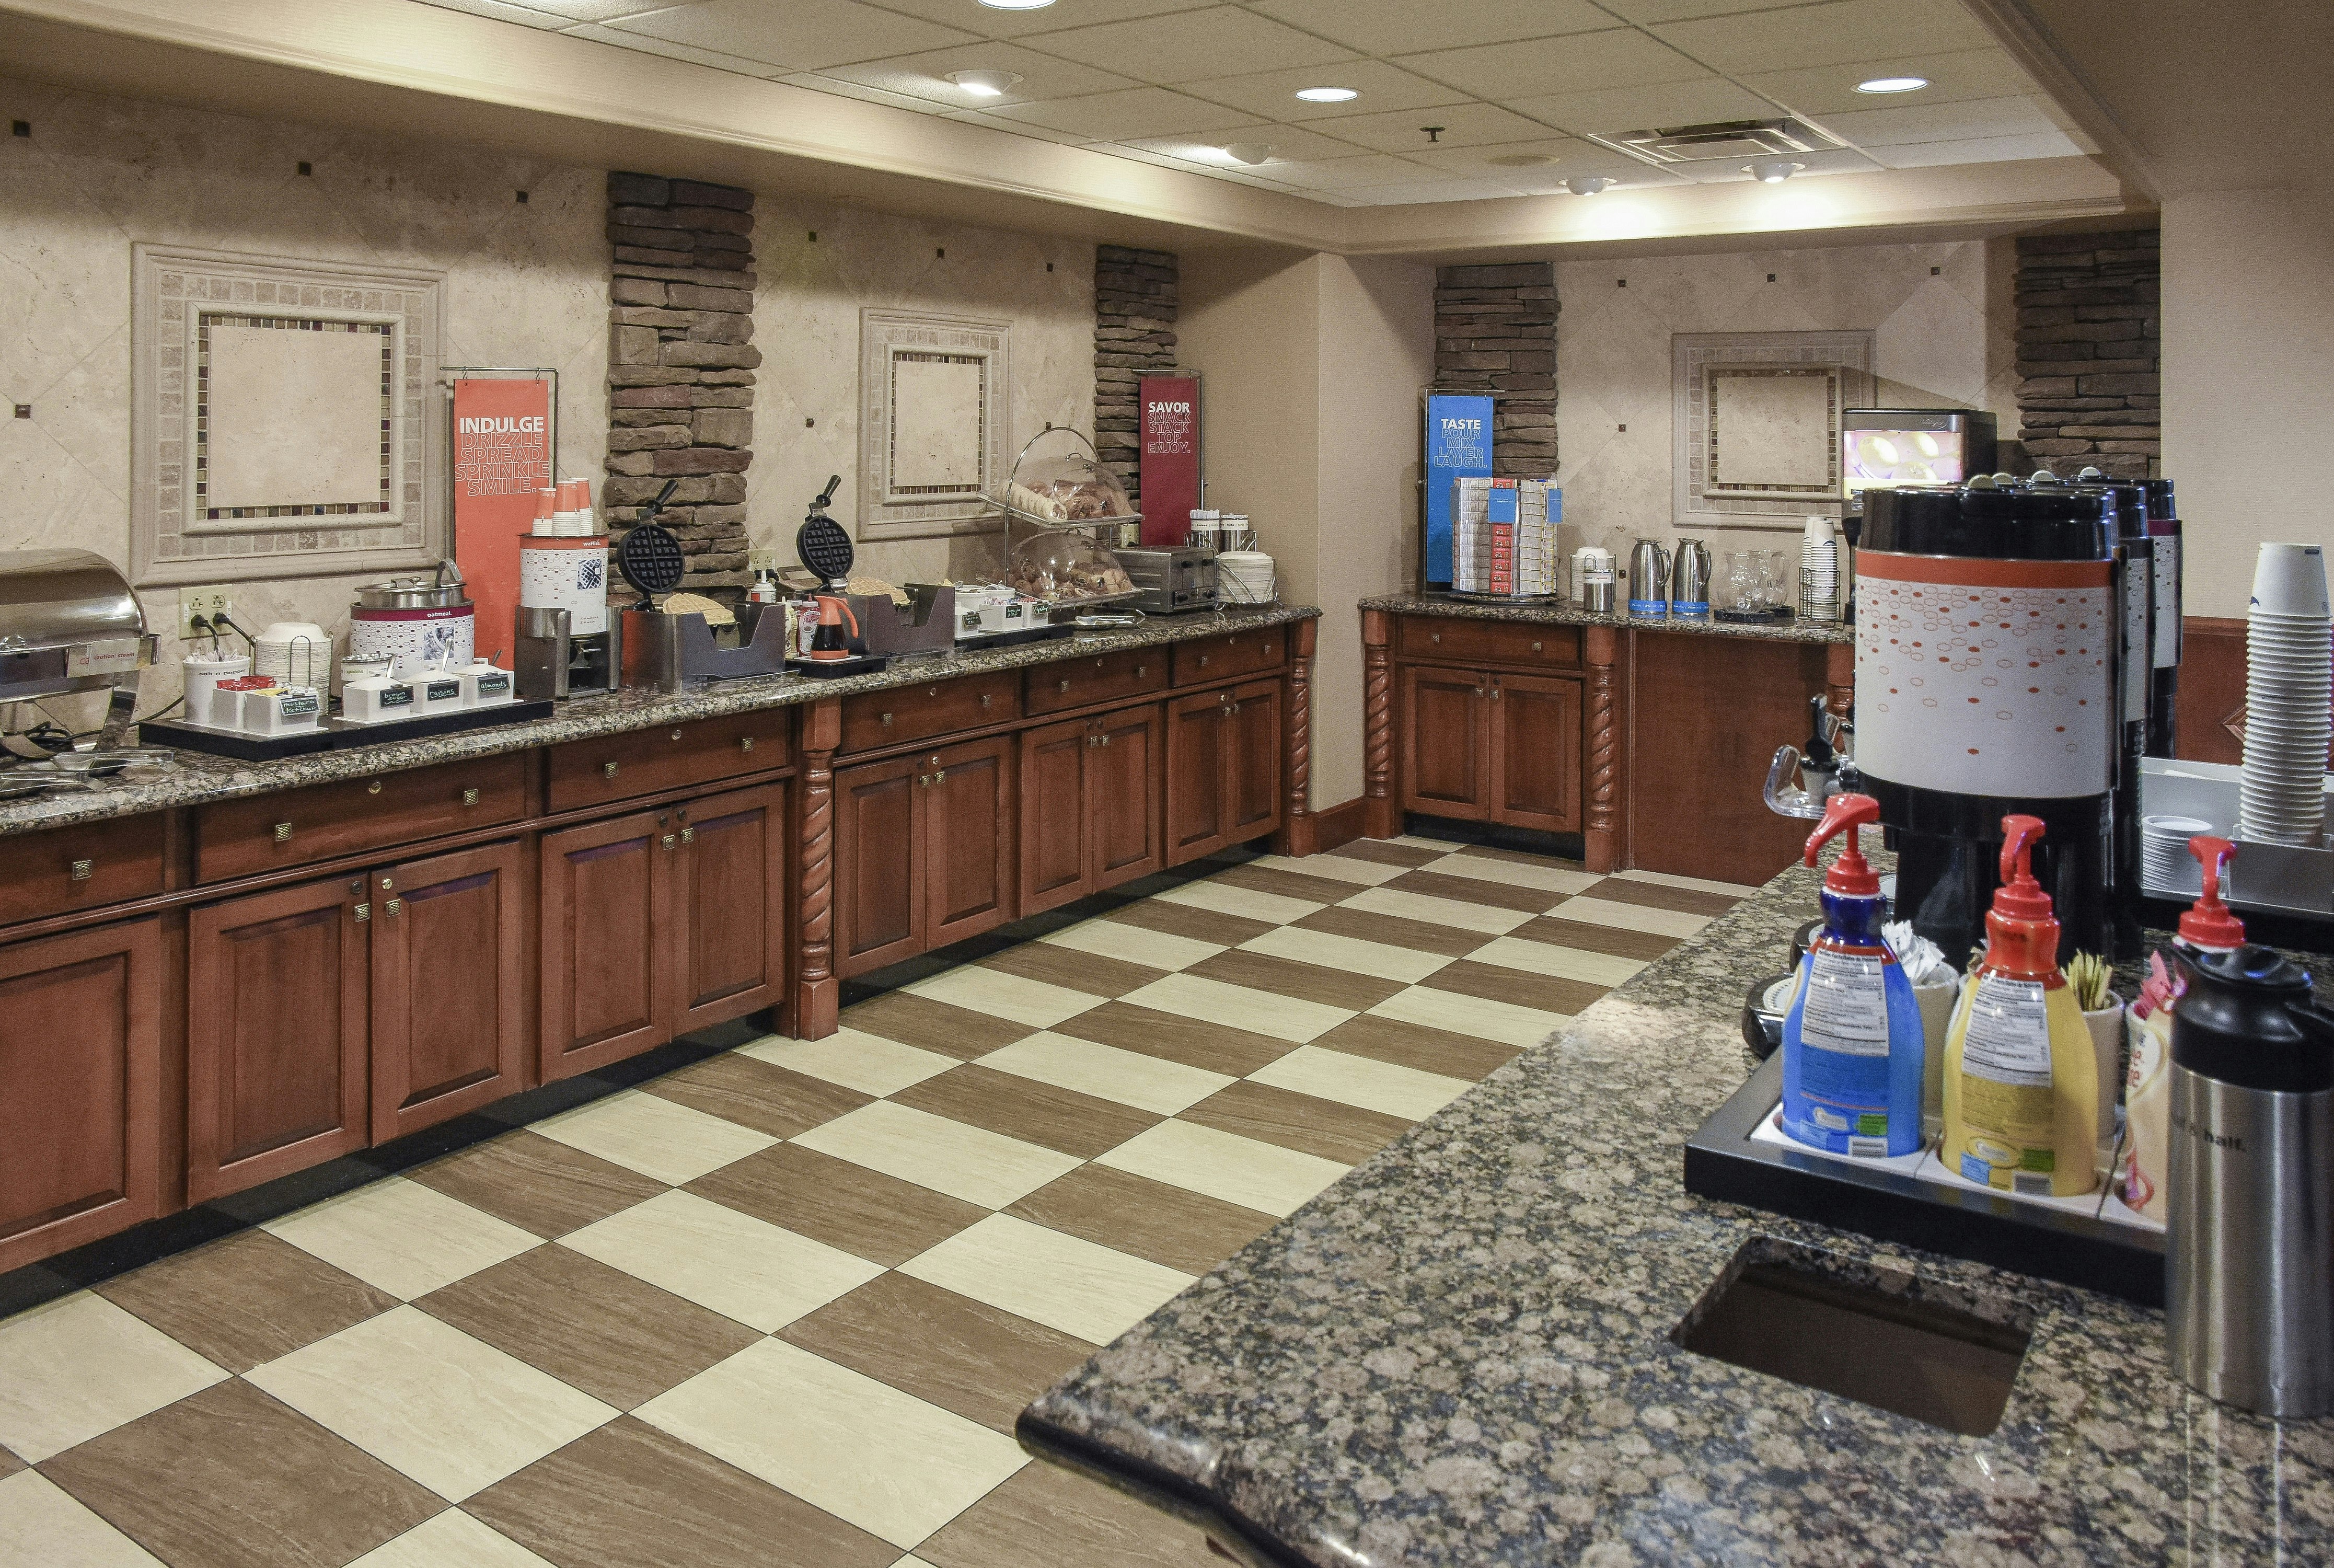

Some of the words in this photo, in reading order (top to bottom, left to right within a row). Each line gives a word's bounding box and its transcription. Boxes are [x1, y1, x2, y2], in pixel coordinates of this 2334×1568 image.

[1149, 402, 1190, 413] SAVOR
[1148, 412, 1191, 423] SNACK
[460, 417, 544, 433] INDULGE
[1149, 422, 1189, 433] STACK
[1441, 419, 1481, 429] TASTE
[1157, 432, 1182, 443] TOP
[1441, 429, 1481, 439] POUR
[461, 432, 543, 449] DRIZZLE
[1447, 437, 1475, 448] MIX
[1148, 442, 1191, 453] ENJOY.
[1438, 447, 1483, 458] LAYER
[460, 447, 544, 464] SPREAD
[1434, 457, 1487, 468] LAUGH.
[455, 461, 549, 481] SPRINKLE
[468, 478, 537, 497] SMILE.
